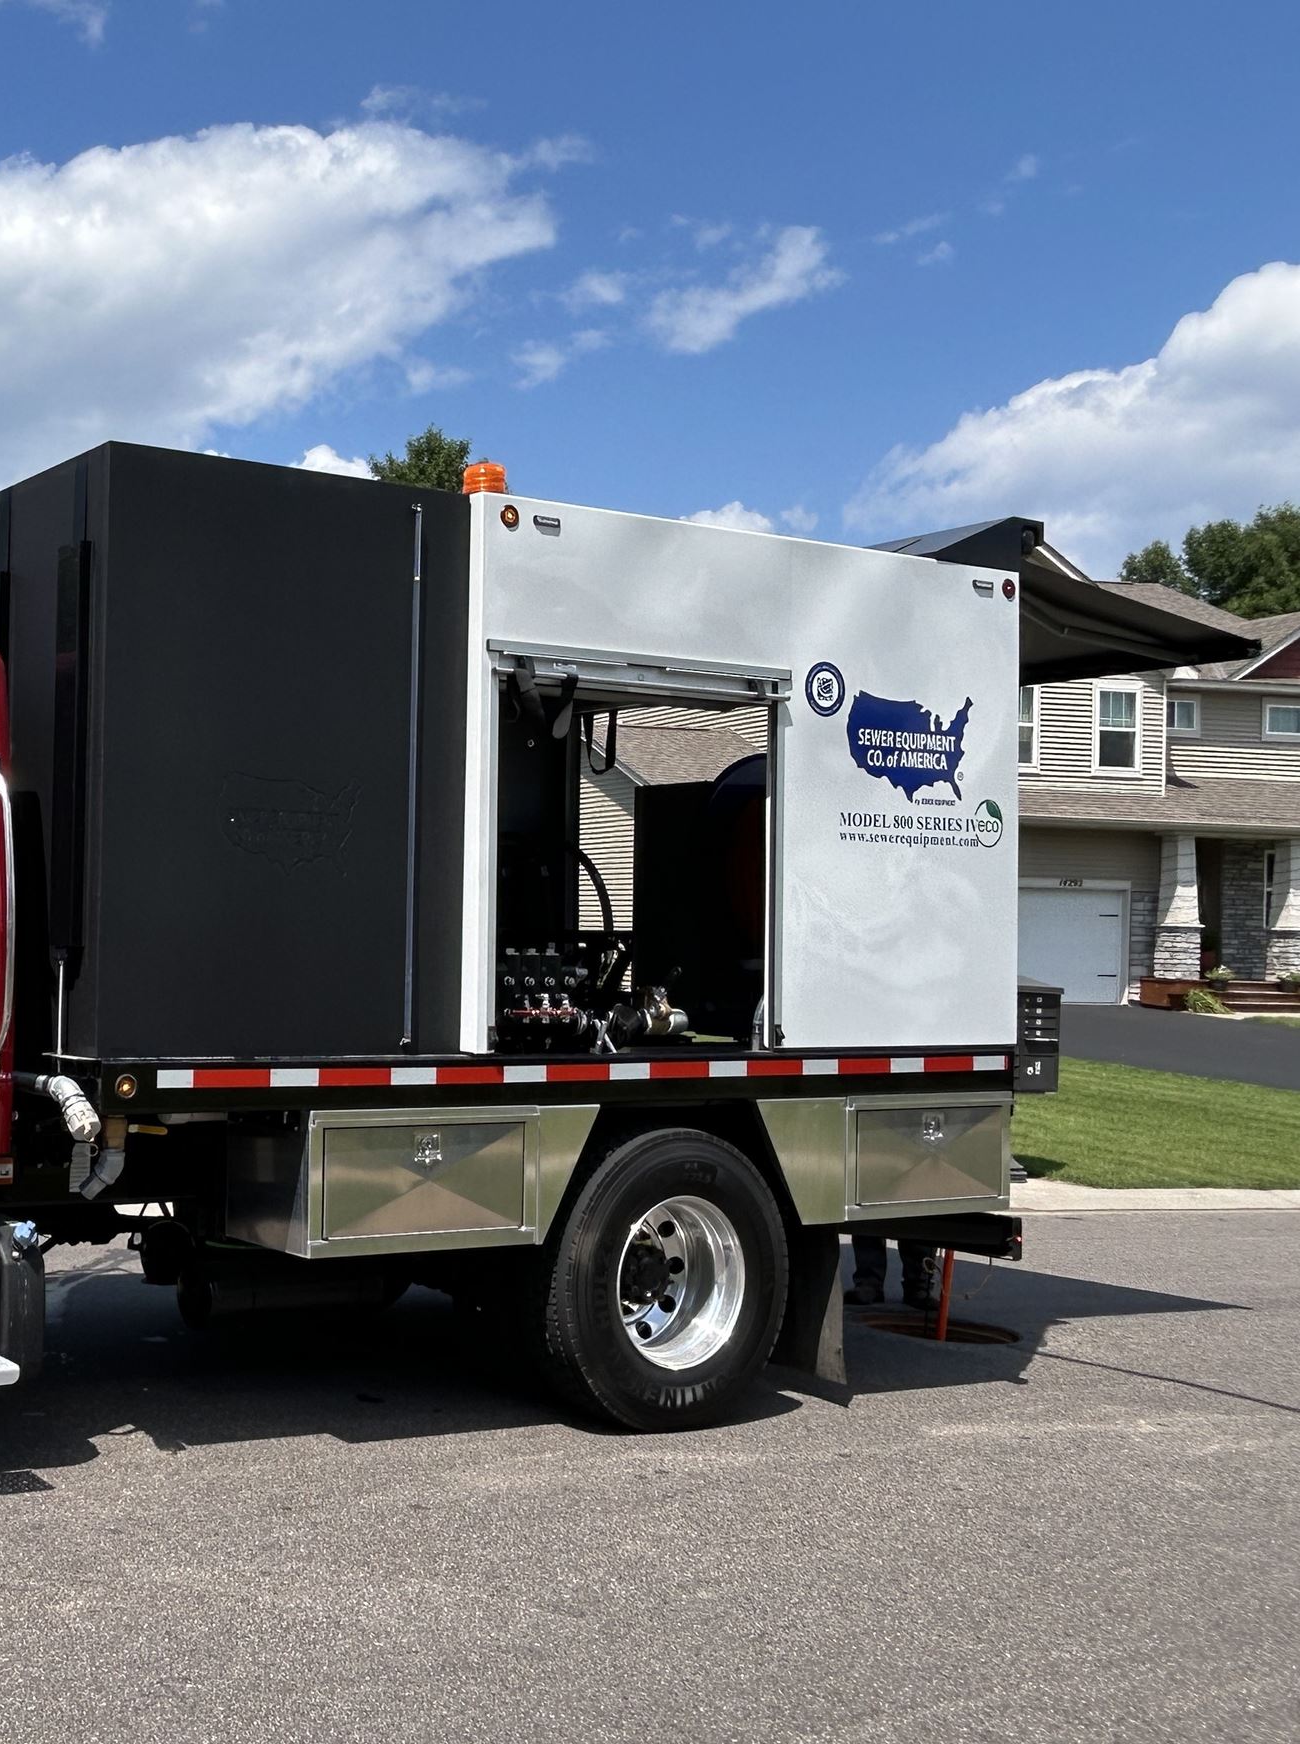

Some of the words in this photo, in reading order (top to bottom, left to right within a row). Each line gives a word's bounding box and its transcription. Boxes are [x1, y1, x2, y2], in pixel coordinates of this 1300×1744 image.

[858, 728, 894, 748] SEWER
[895, 731, 956, 752] EQUIPMENT
[867, 749, 885, 767] CO.
[886, 751, 899, 768] of
[900, 751, 948, 770] AMERICA
[839, 812, 891, 829] MODEL
[893, 815, 913, 830] 800
[916, 816, 963, 832] SERIES
[977, 820, 999, 833] eco
[839, 833, 979, 848] www.sewerequipment.com
